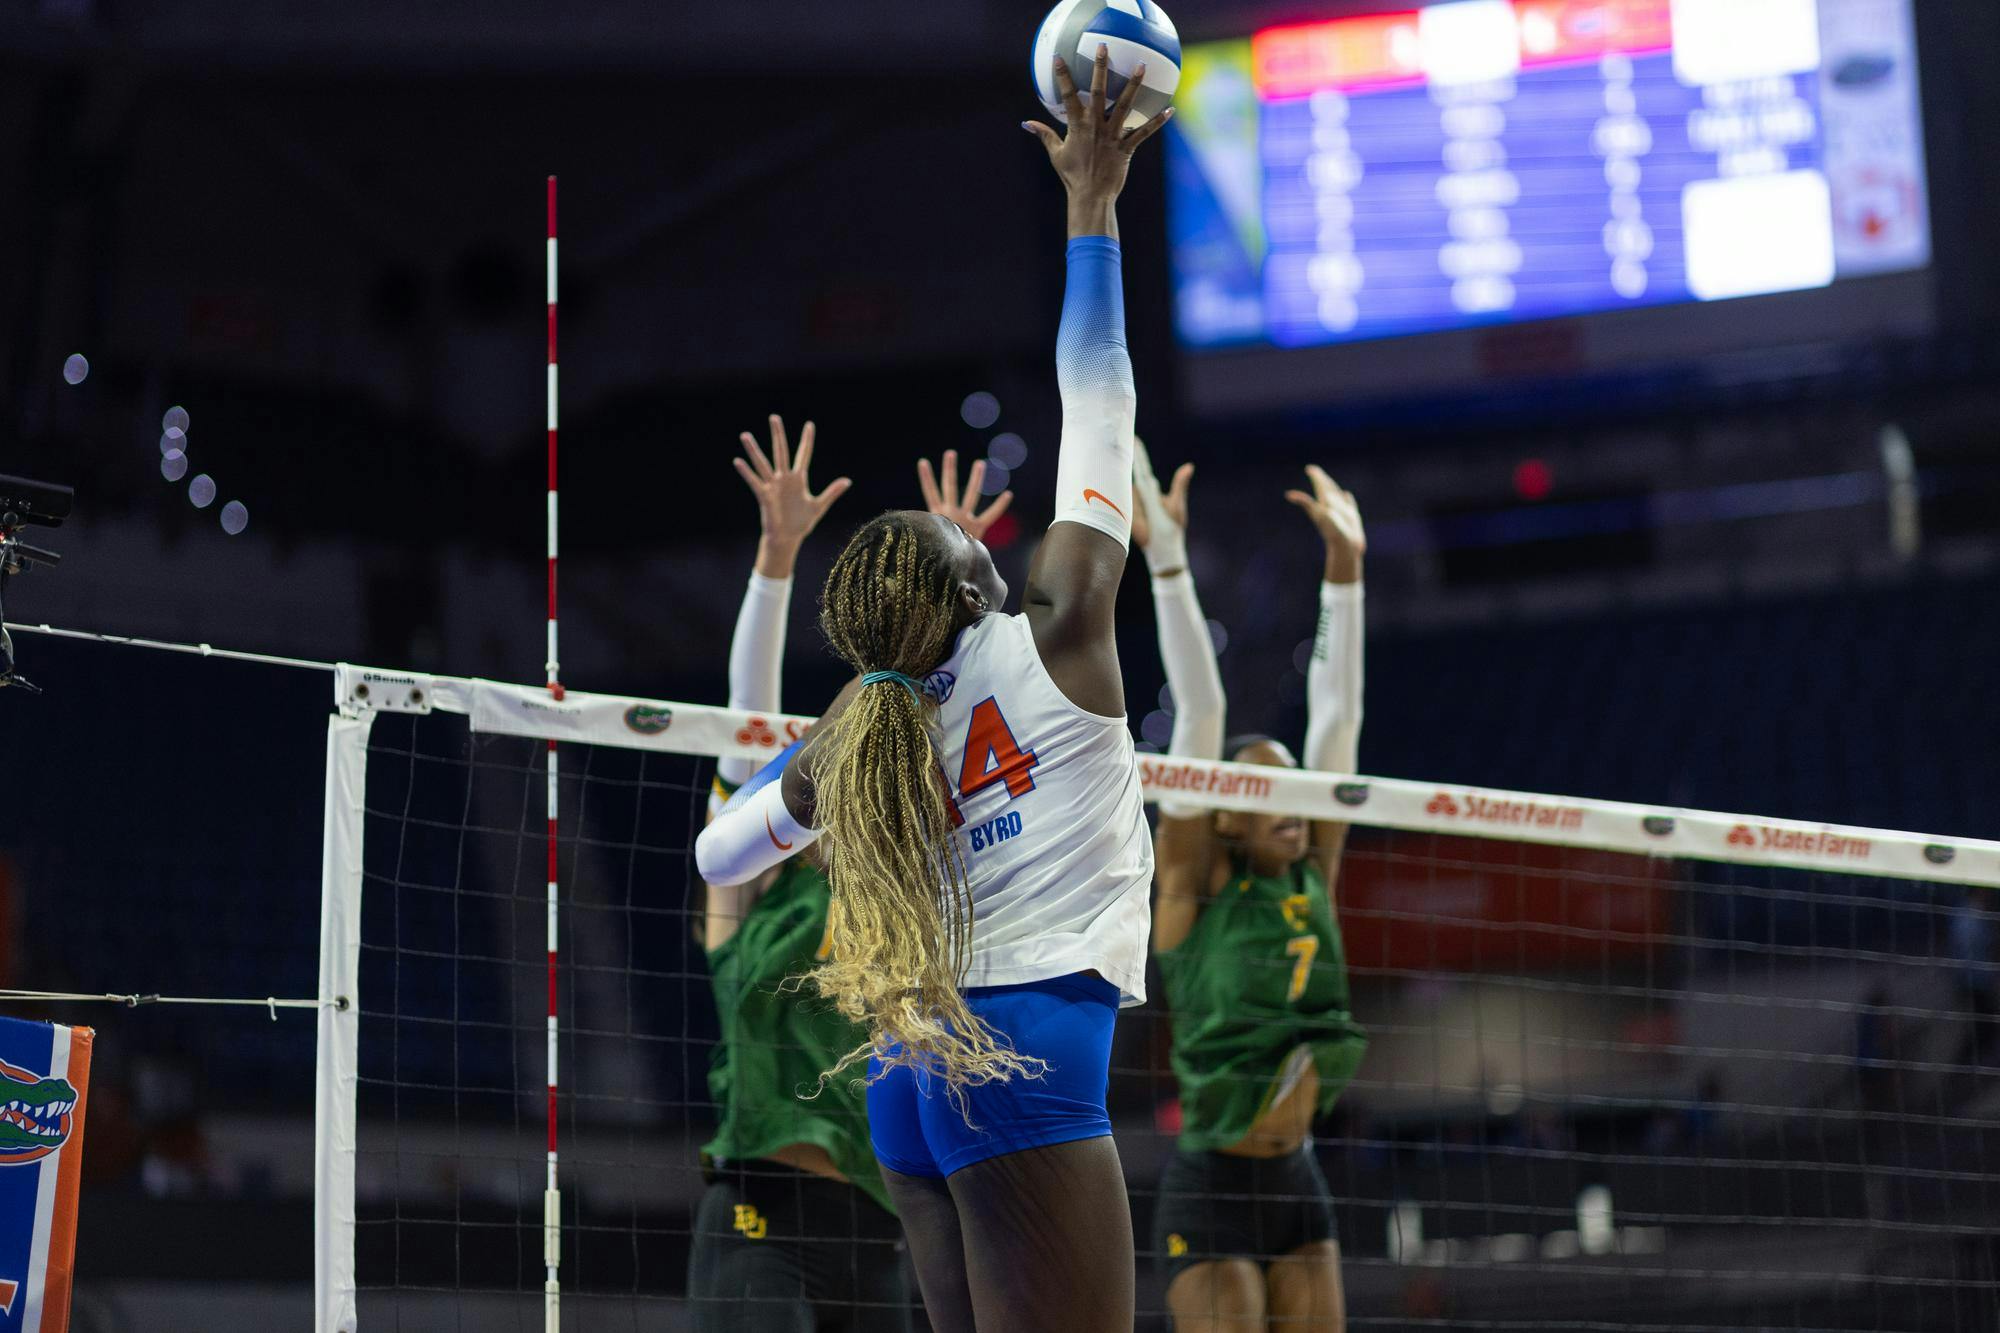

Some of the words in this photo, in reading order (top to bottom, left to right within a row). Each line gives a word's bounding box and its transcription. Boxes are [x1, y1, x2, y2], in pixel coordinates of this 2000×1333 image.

[942, 694, 1040, 826] 4
[970, 811, 1023, 852] BYRD
[1286, 935, 1319, 1002] 7
